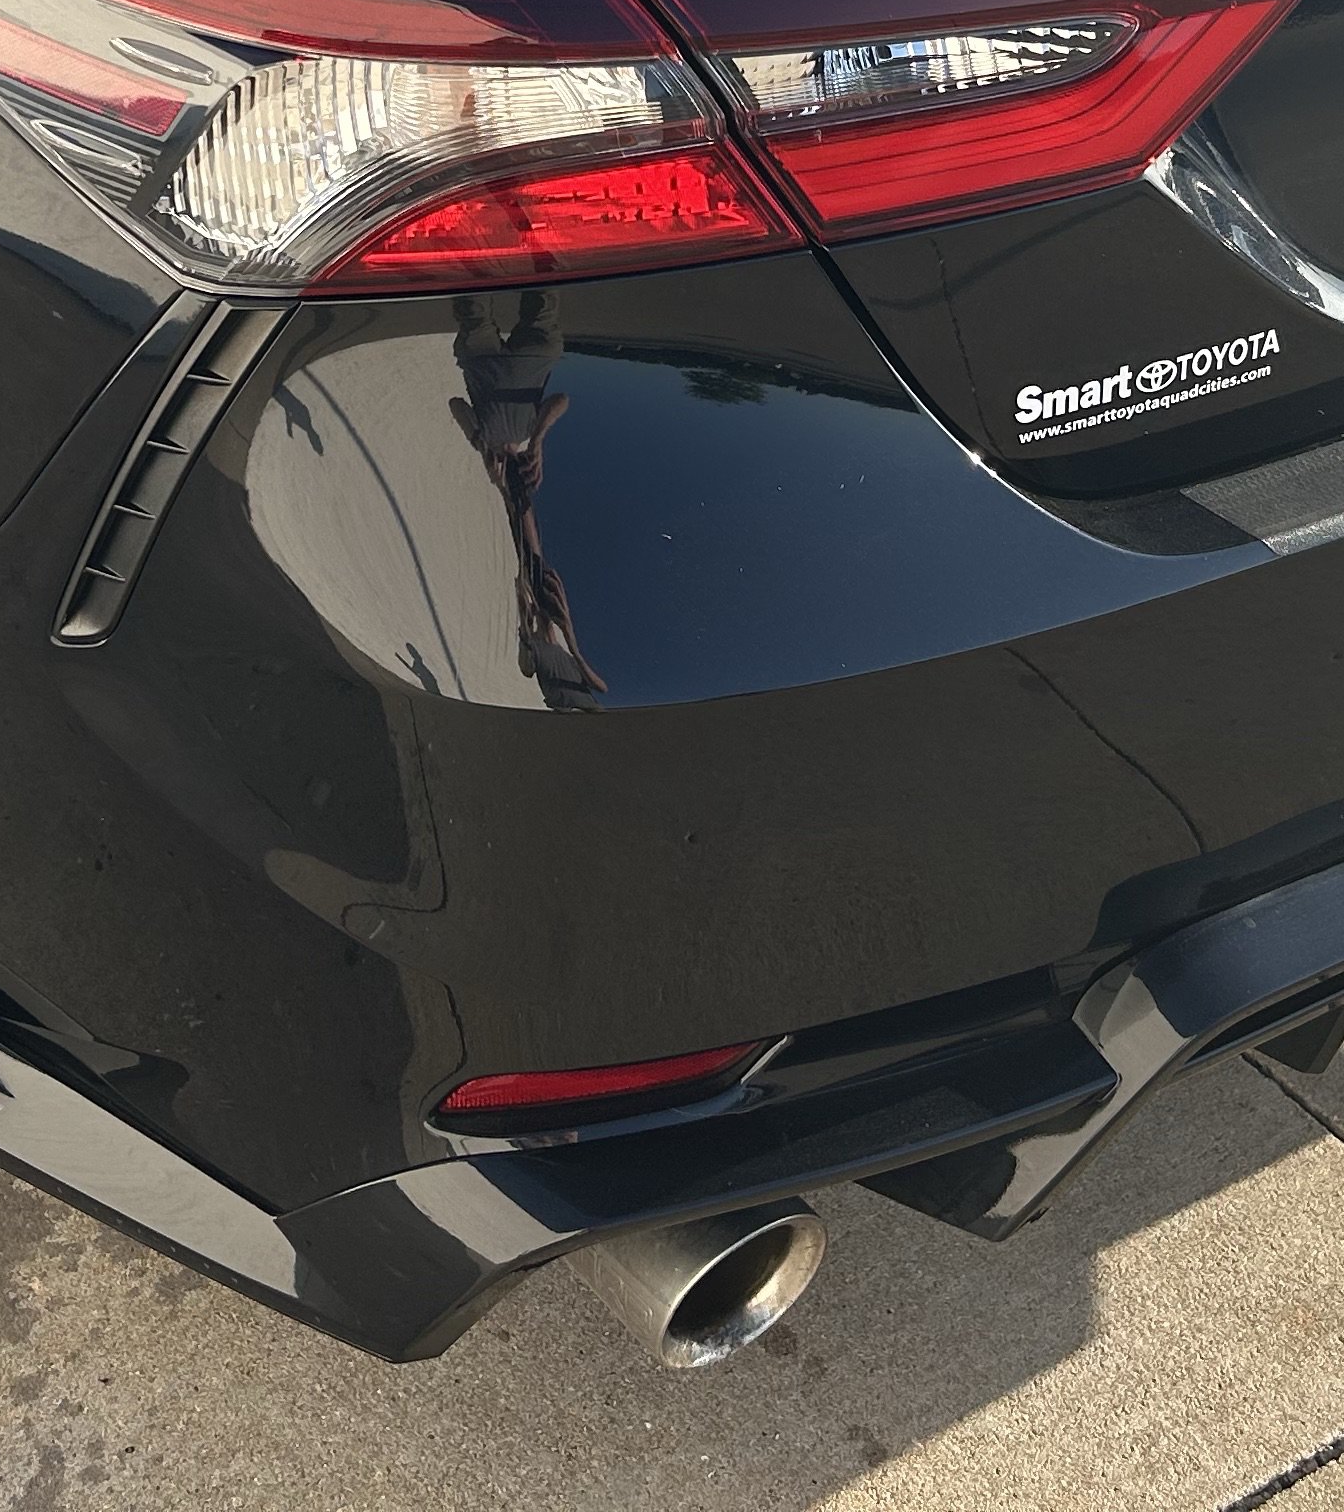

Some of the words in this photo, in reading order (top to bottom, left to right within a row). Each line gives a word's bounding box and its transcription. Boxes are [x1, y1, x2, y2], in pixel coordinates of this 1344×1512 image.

[1014, 364, 1133, 425] Smart
[1176, 328, 1281, 381] TOYOTA
[1018, 364, 1272, 445] www.smarttoyotaquadcities.com
